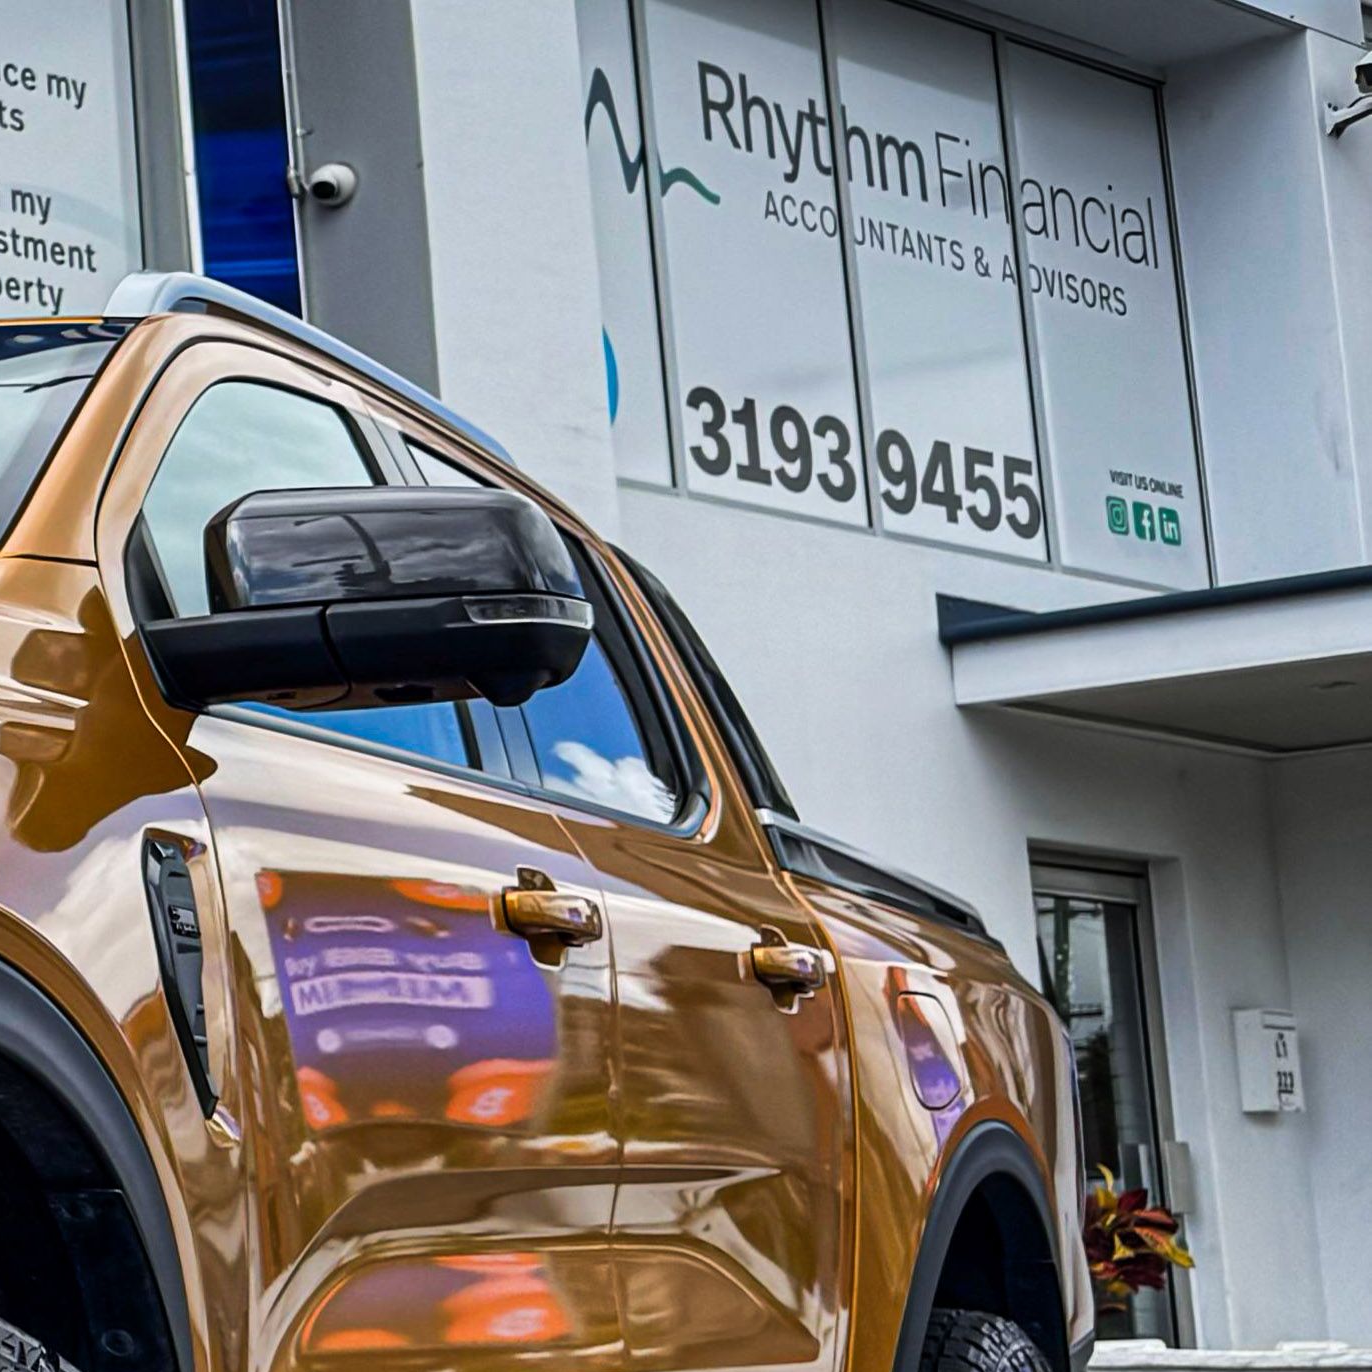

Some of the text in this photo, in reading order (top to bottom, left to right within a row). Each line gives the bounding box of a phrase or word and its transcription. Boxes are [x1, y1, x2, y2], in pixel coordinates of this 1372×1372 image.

[46, 73, 87, 110] my
[11, 189, 52, 226] my
[973, 246, 992, 278] &
[685, 386, 1042, 540] 3193 9455
[1109, 469, 1184, 499] VISIT US ONLINE
